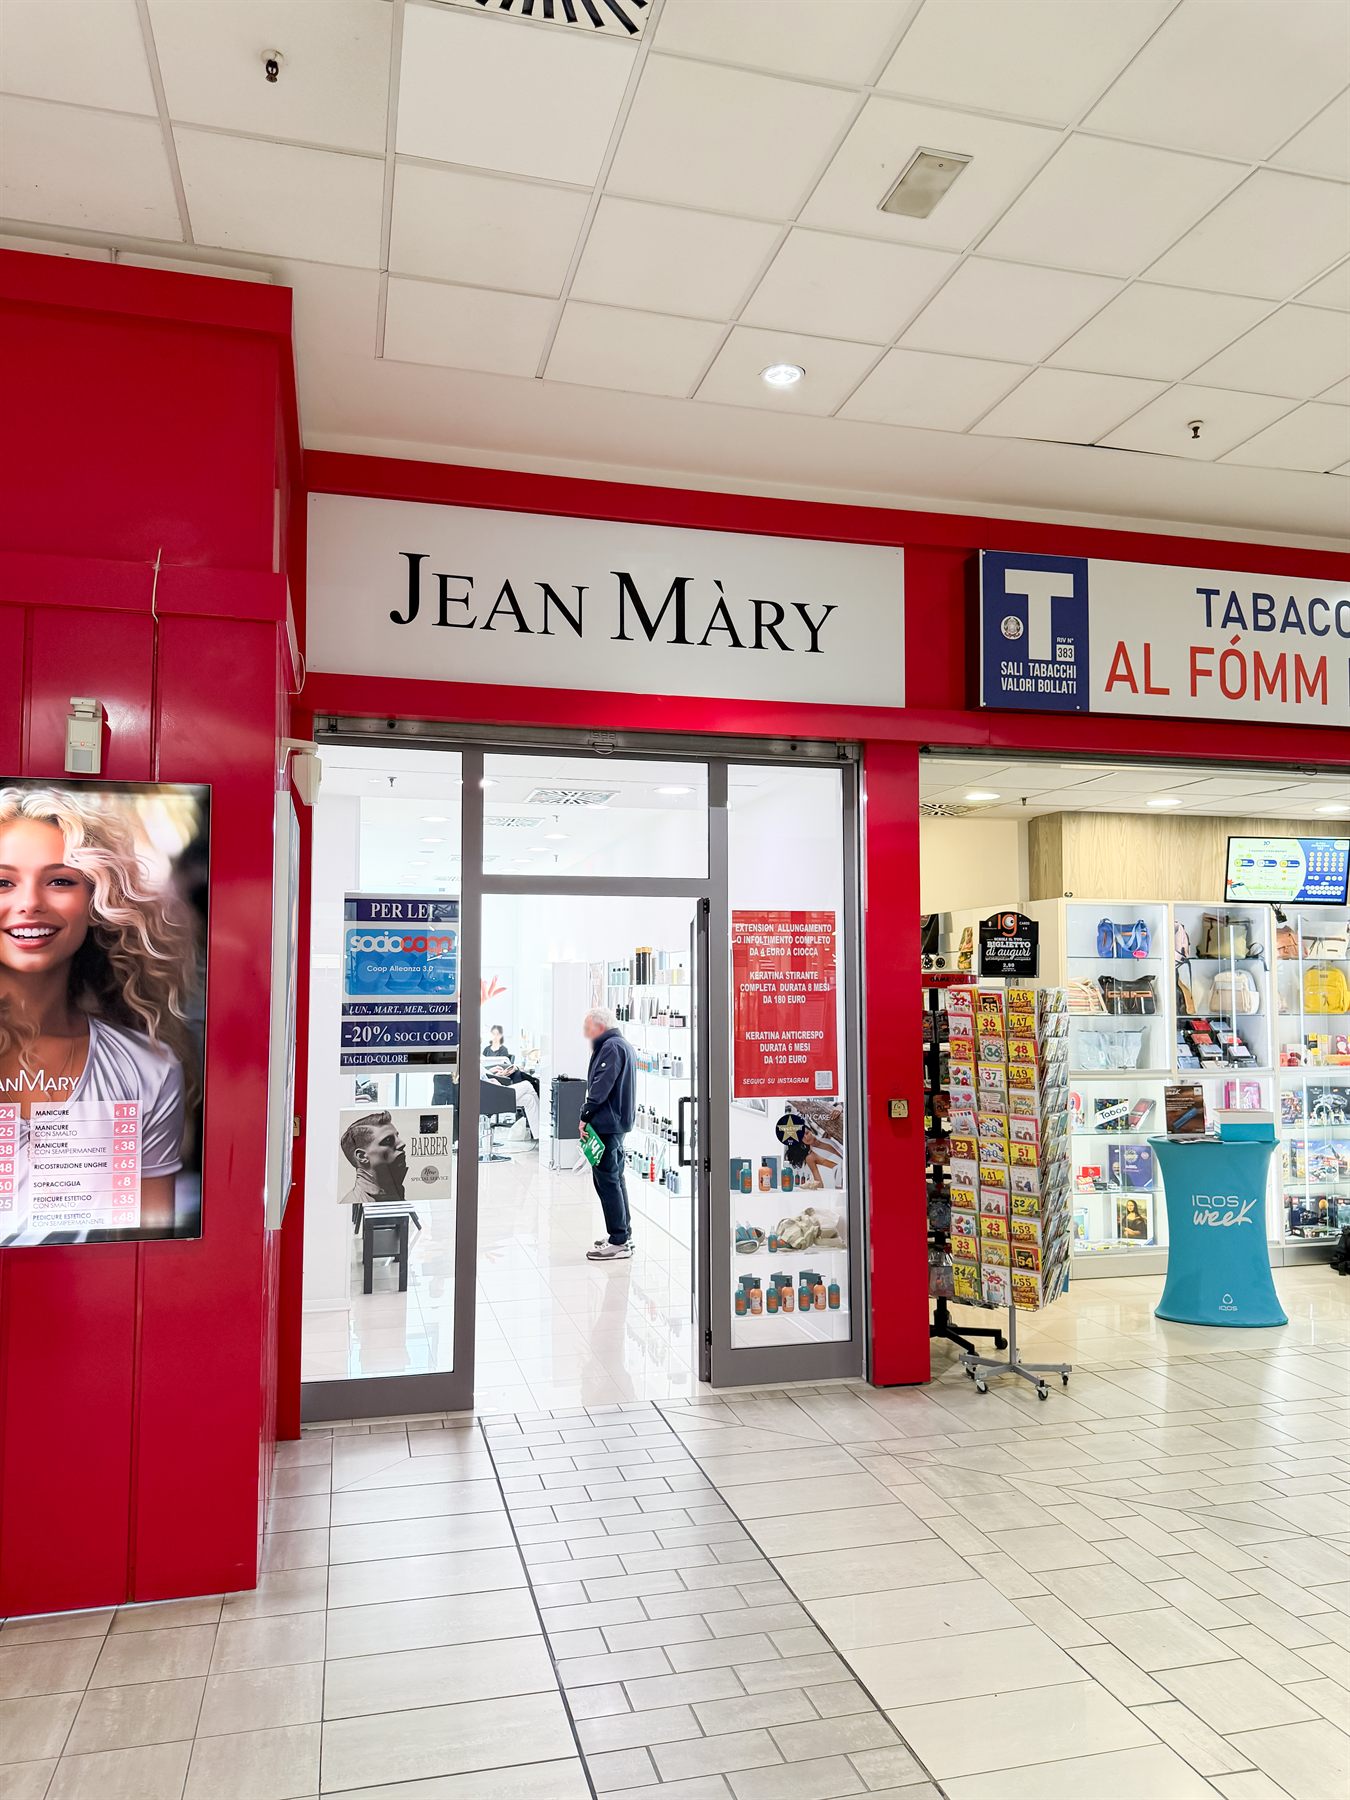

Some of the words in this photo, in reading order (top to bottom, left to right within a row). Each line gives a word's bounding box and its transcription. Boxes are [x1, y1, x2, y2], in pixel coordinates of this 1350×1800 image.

[389, 551, 590, 638] JEAN
[609, 570, 838, 653] MÀRY
[1004, 568, 1074, 661] T
[1057, 647, 1073, 658] 383
[1000, 661, 1023, 676] SALI
[1028, 663, 1077, 679] TABACCHI
[1104, 641, 1170, 696] AL
[1189, 634, 1328, 705] FÓMM
[1001, 677, 1035, 692] VALORI
[1037, 679, 1077, 694] BOLLATI
[371, 903, 402, 918] PER
[407, 903, 435, 919] LEI
[777, 923, 832, 932] ALLUNGAMENTO
[736, 935, 742, 944] O
[743, 935, 793, 944] INFOLTIMENTO
[794, 935, 831, 944] COMPLETO
[749, 947, 758, 956] DA
[766, 947, 785, 956] EURO
[786, 947, 792, 956] A
[793, 947, 819, 956] CIOCCA
[749, 971, 784, 980] KERATINA
[785, 971, 819, 979] STIRANTE
[740, 983, 777, 992] COMPLETA
[779, 983, 806, 992] DURATA
[813, 983, 830, 992] MESI
[762, 995, 772, 1004] DA
[774, 995, 786, 1004] 180
[787, 995, 806, 1004] EURO
[982, 1019, 996, 1027] 36
[345, 1026, 391, 1042] -20%
[394, 1032, 420, 1041] SOCI
[423, 1031, 454, 1041] COOP
[745, 1031, 780, 1040] KERATINA
[781, 1030, 824, 1040] ANTICRESPO
[760, 1043, 787, 1052] DURATA
[788, 1043, 792, 1052] 6
[794, 1042, 811, 1052] MESI
[986, 1047, 1000, 1057] 36
[1014, 1045, 1029, 1054] 48
[343, 1054, 409, 1064] TAGLIO-COLORE
[764, 1055, 773, 1064] DA
[775, 1055, 787, 1064] 120
[788, 1055, 807, 1063] EURO
[985, 1072, 997, 1080] 37
[1099, 1106, 1128, 1119] Taboo
[411, 1136, 448, 1156] BARBER
[955, 1142, 968, 1152] 29
[1191, 1195, 1239, 1208] IQOS
[987, 1222, 1000, 1232] 43
[957, 1240, 970, 1249] 33
